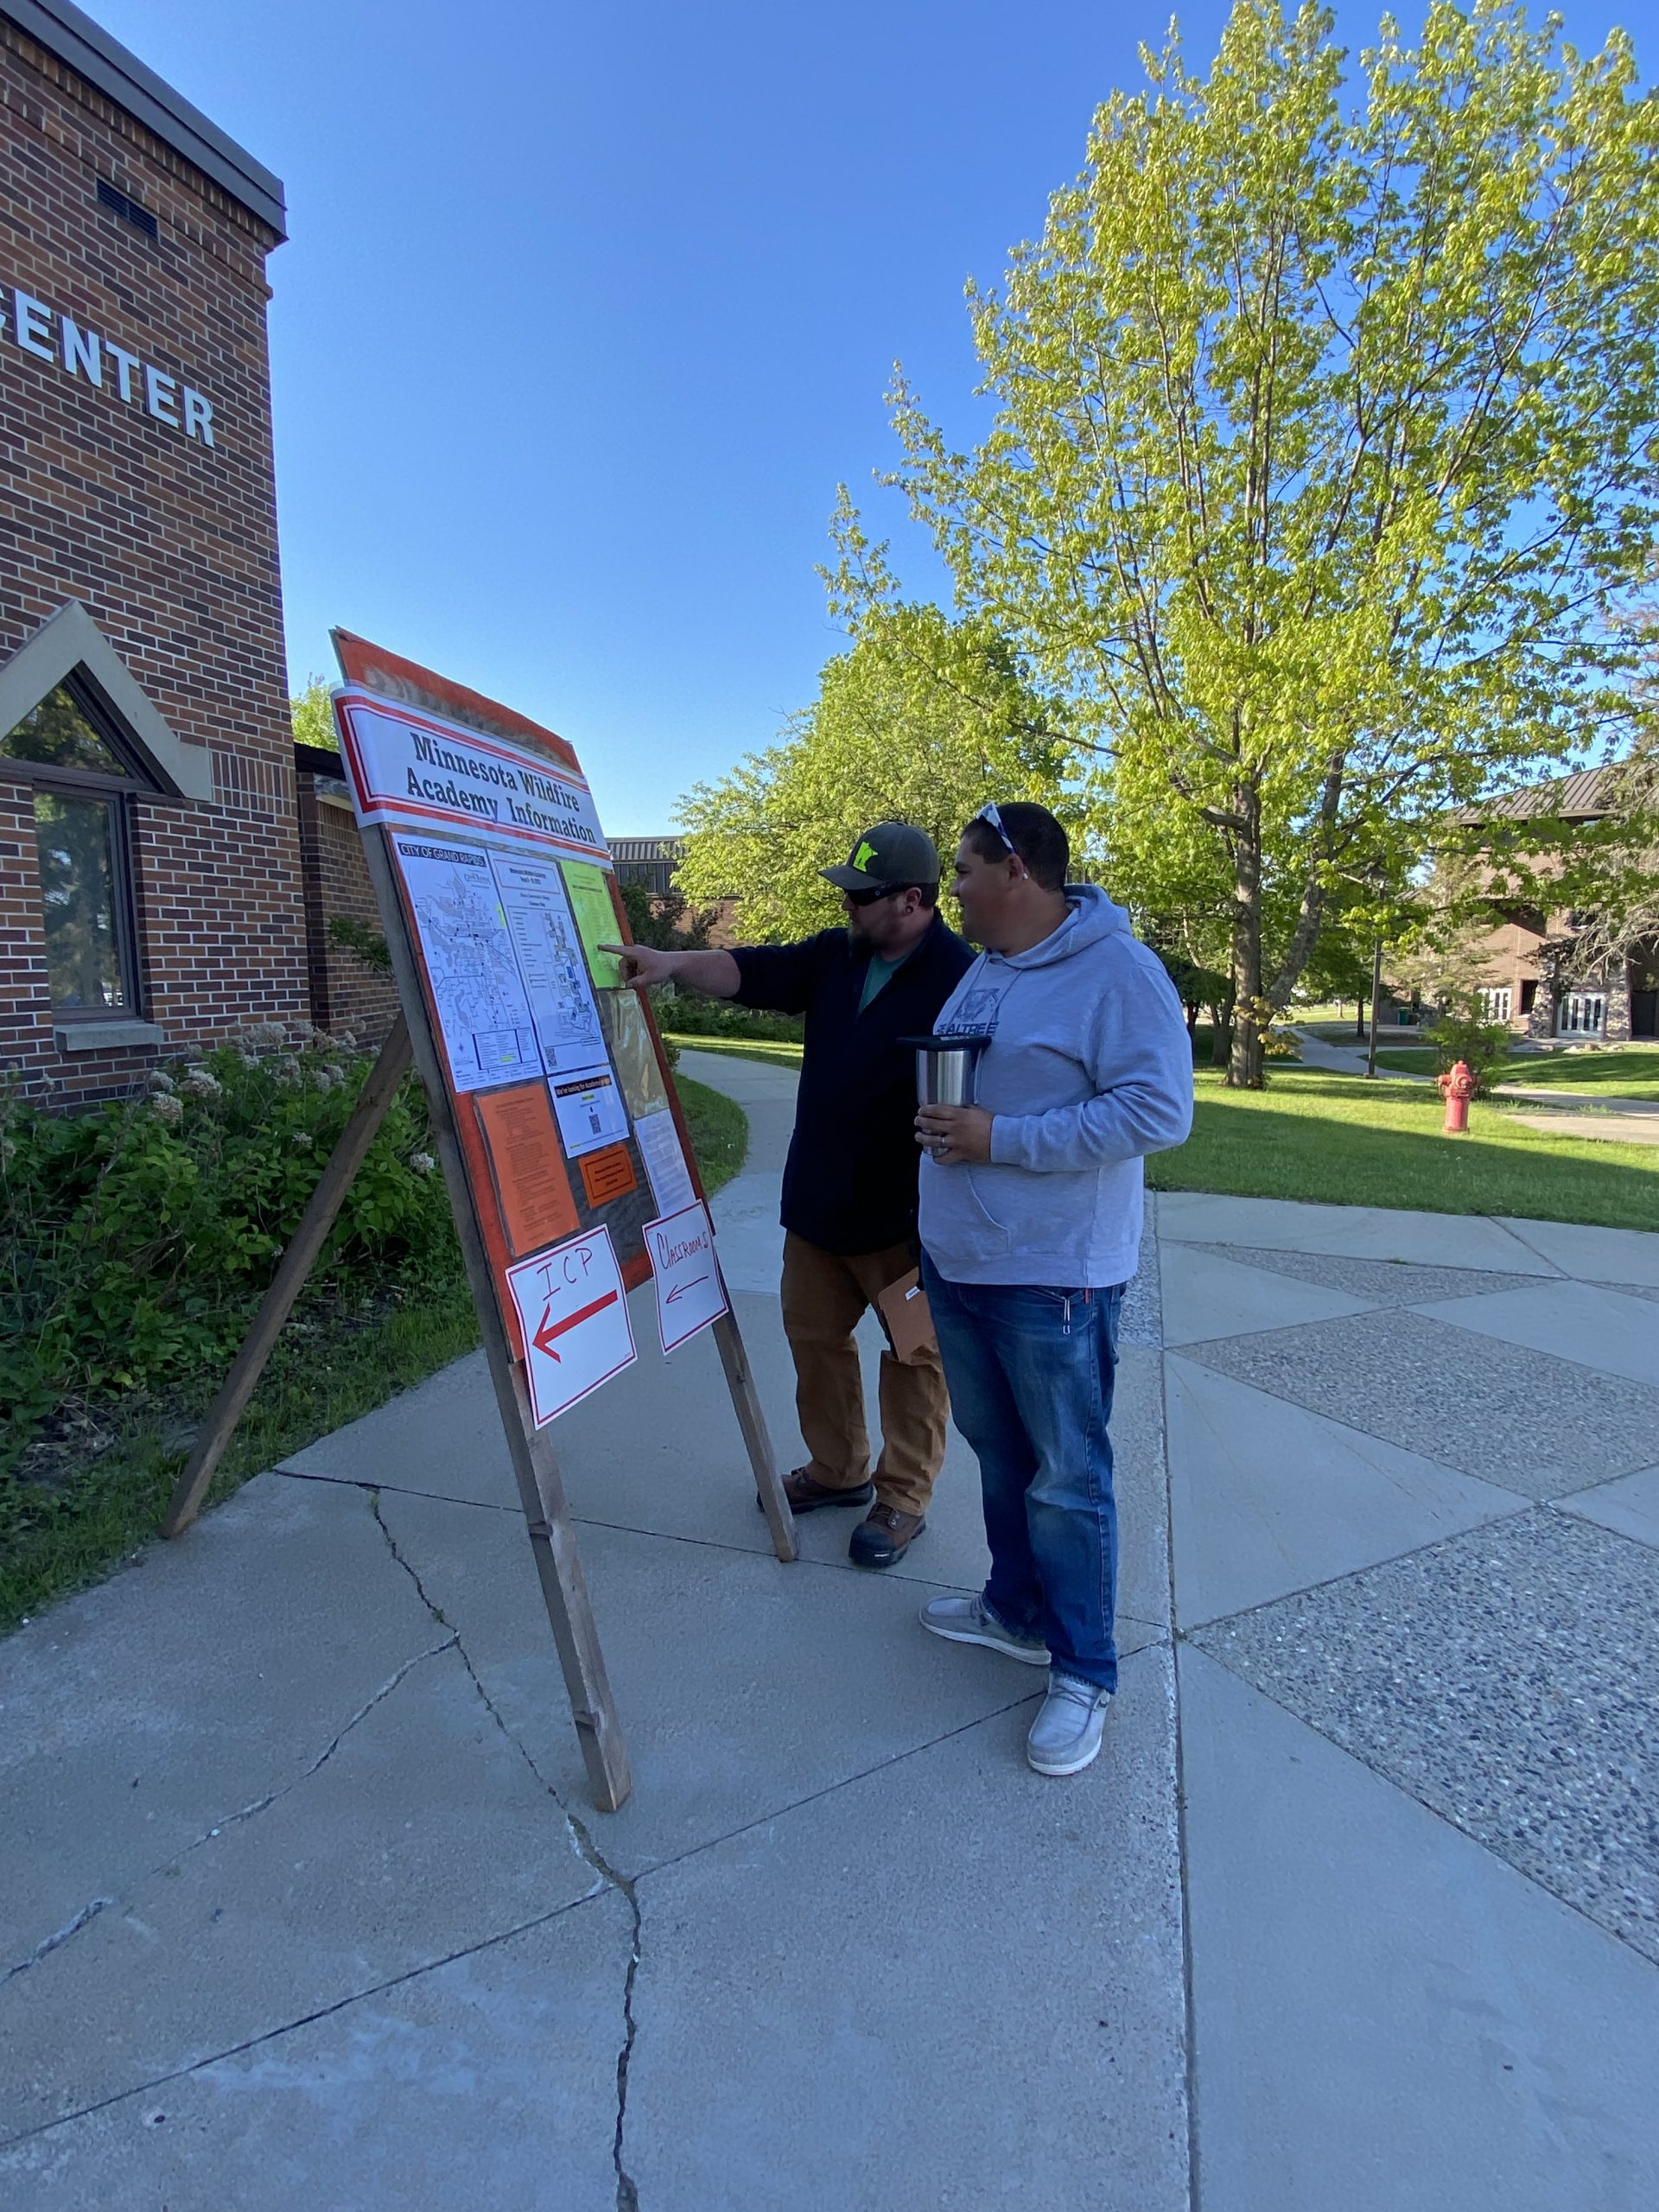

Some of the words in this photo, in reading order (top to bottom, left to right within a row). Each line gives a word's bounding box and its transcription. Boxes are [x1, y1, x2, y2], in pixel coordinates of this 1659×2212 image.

[0, 286, 215, 448] ENTER
[407, 766, 499, 823] Academy
[506, 797, 597, 844] Information
[410, 732, 518, 791] Minnesota
[517, 769, 581, 812] Wildfire
[401, 844, 420, 857] CITY
[421, 847, 433, 858] OF
[433, 849, 459, 862] GRAND
[460, 853, 484, 866] RAPIDS
[537, 1248, 593, 1301] ICP
